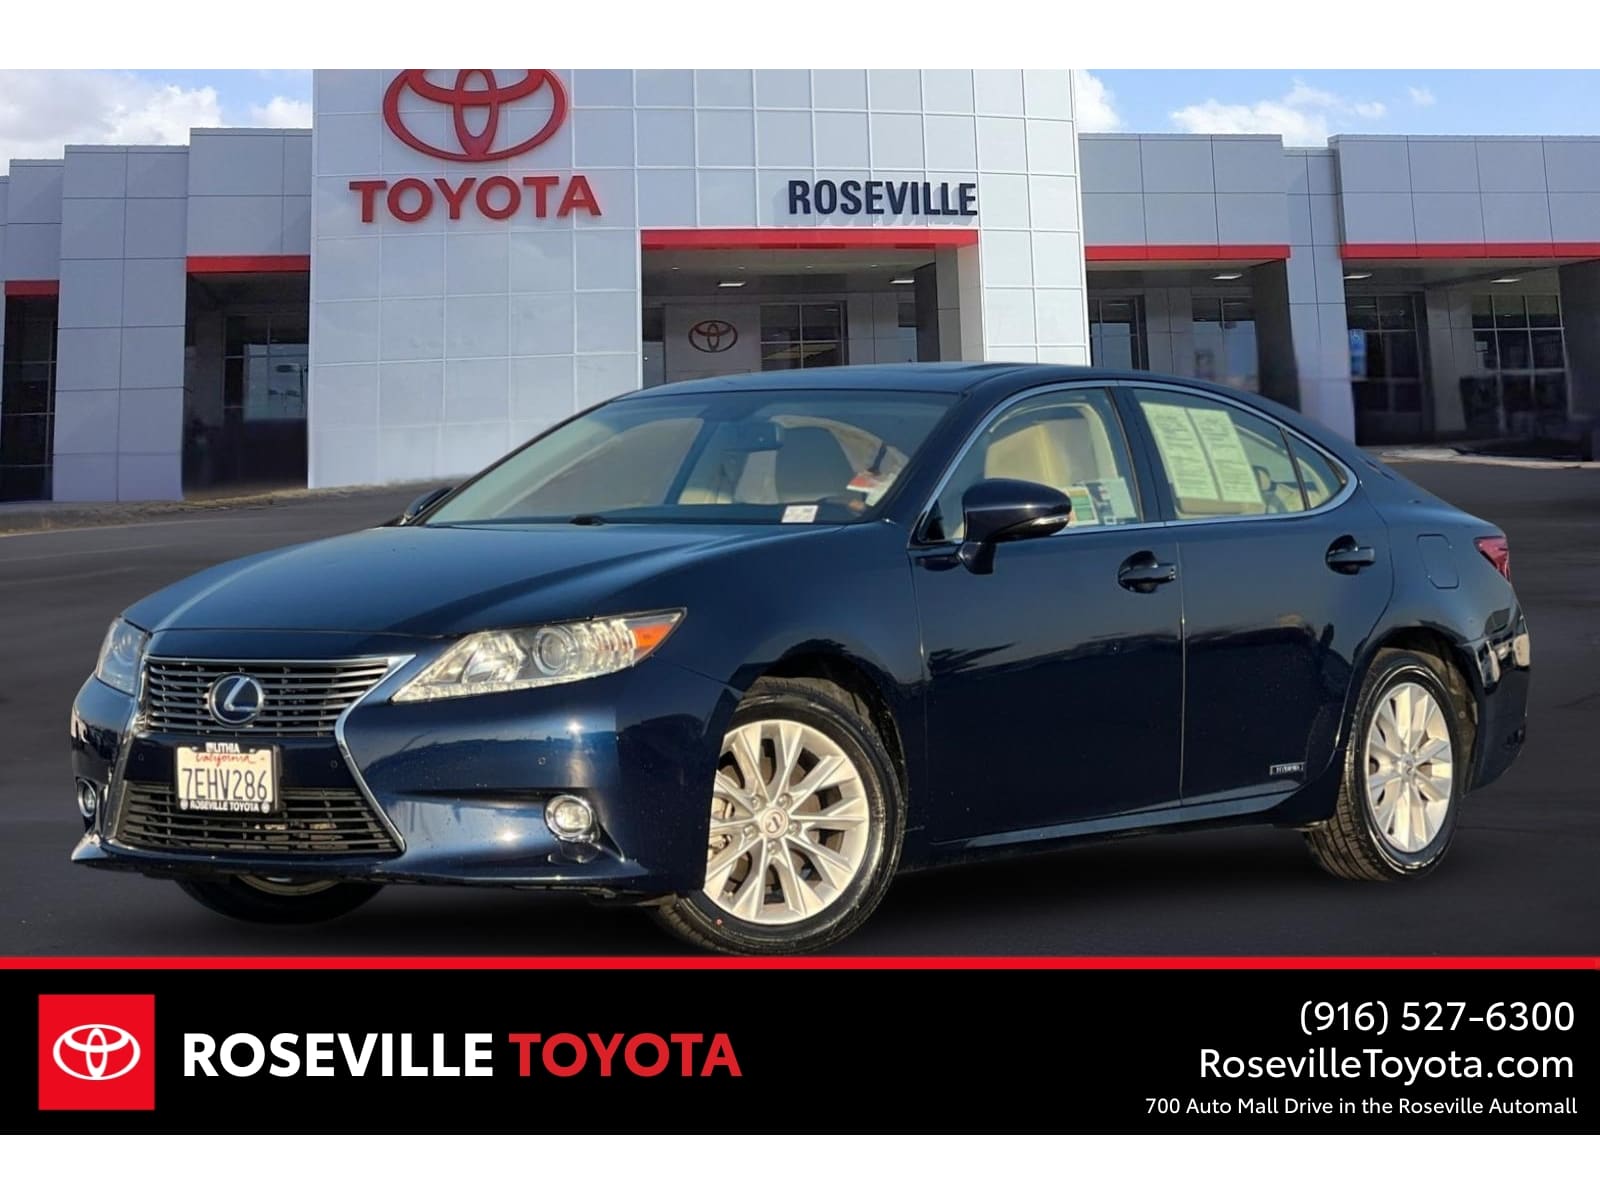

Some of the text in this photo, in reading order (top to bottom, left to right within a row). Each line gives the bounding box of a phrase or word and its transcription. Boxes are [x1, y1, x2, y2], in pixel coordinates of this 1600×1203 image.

[349, 175, 602, 223] TOYOTA
[788, 179, 979, 217] ROSEVILLE
[181, 768, 268, 801] 7EHV286
[229, 801, 260, 813] TOYOTA
